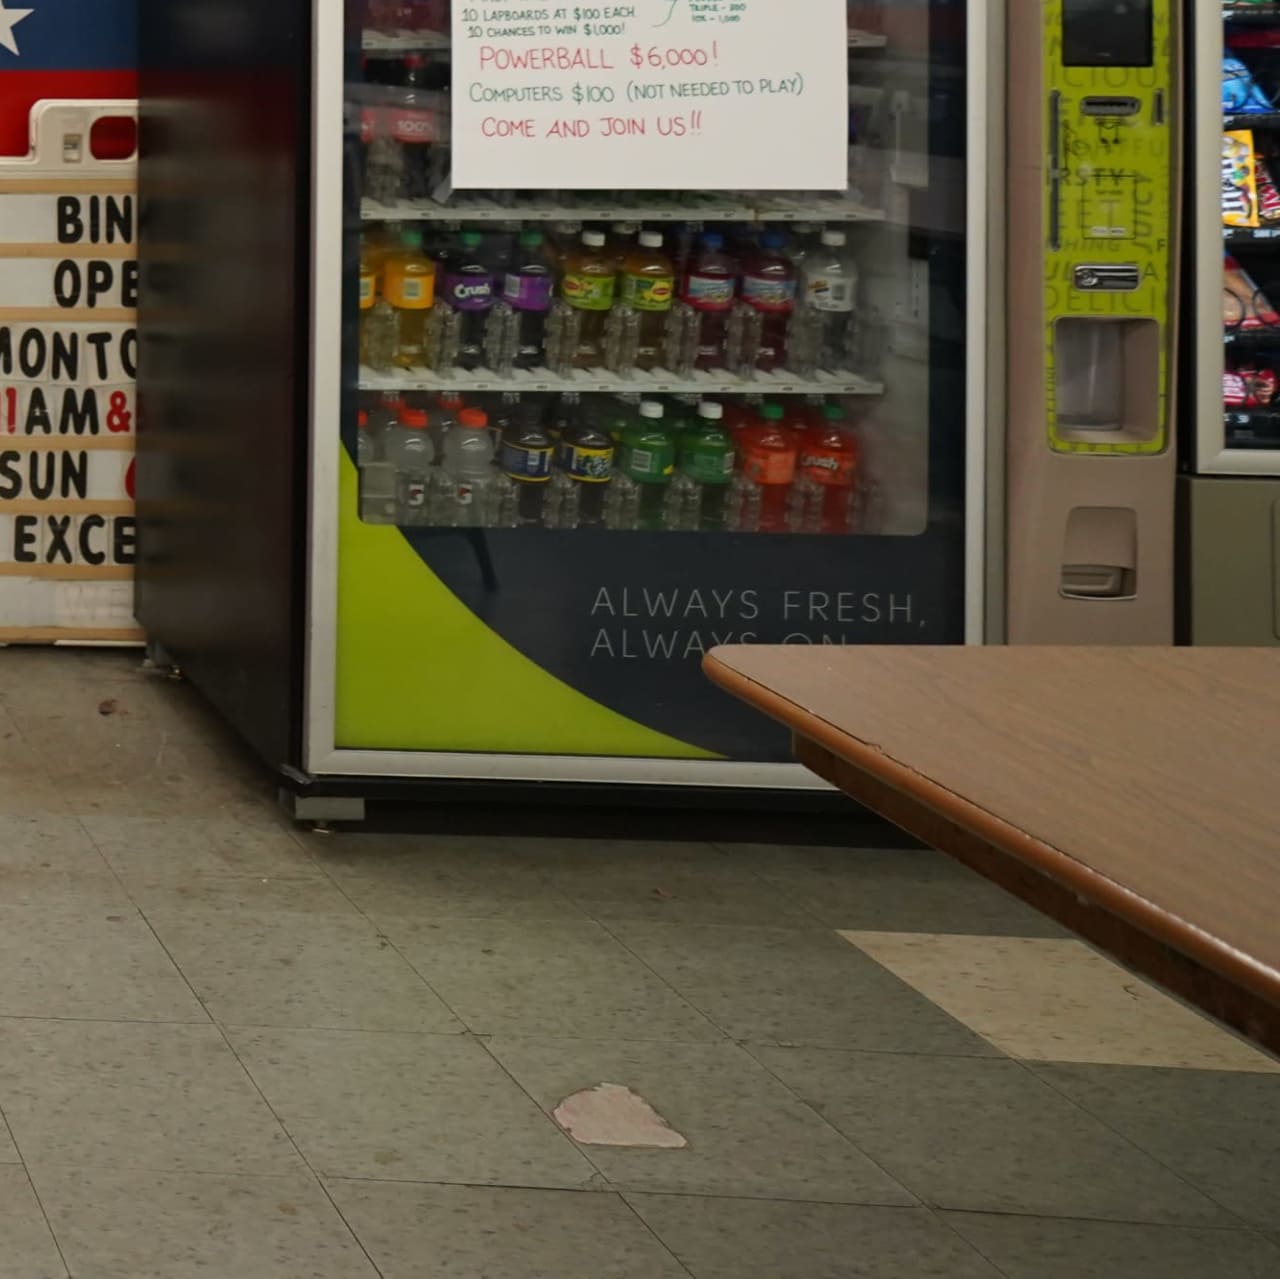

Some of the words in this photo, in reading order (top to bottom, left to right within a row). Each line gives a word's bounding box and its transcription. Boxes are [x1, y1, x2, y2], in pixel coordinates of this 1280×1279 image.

[57, 195, 133, 244] BIN
[14, 514, 136, 565] EXCE
[590, 586, 759, 619] ALWAYS
[784, 591, 926, 628] FRESH,
